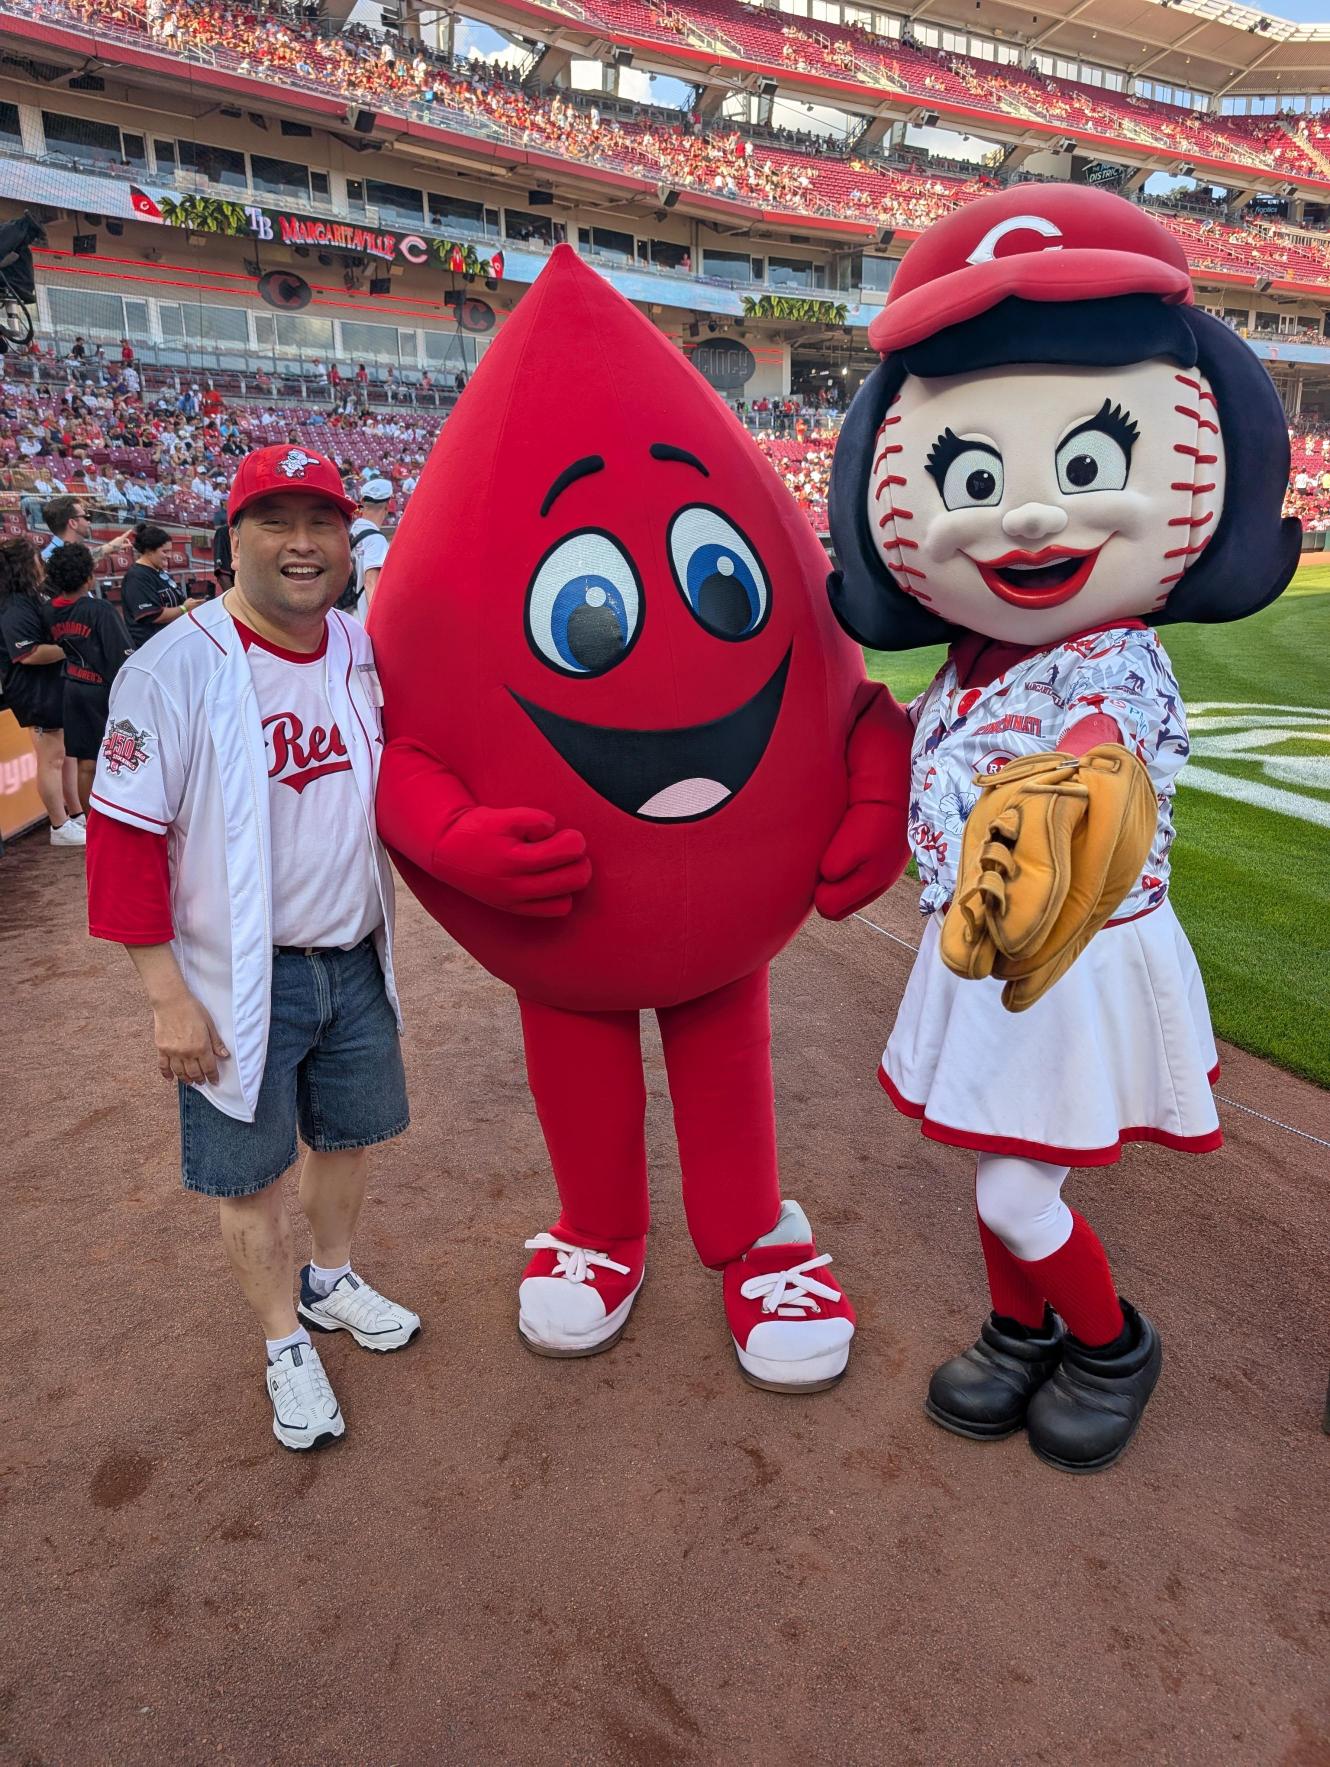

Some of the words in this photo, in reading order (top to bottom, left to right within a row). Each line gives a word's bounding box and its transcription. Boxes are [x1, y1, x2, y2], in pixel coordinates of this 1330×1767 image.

[244, 206, 274, 241] TB
[278, 215, 397, 260] MARGARITAVILLE
[965, 214, 1064, 266] C
[398, 234, 429, 265] C
[109, 732, 135, 761] 150
